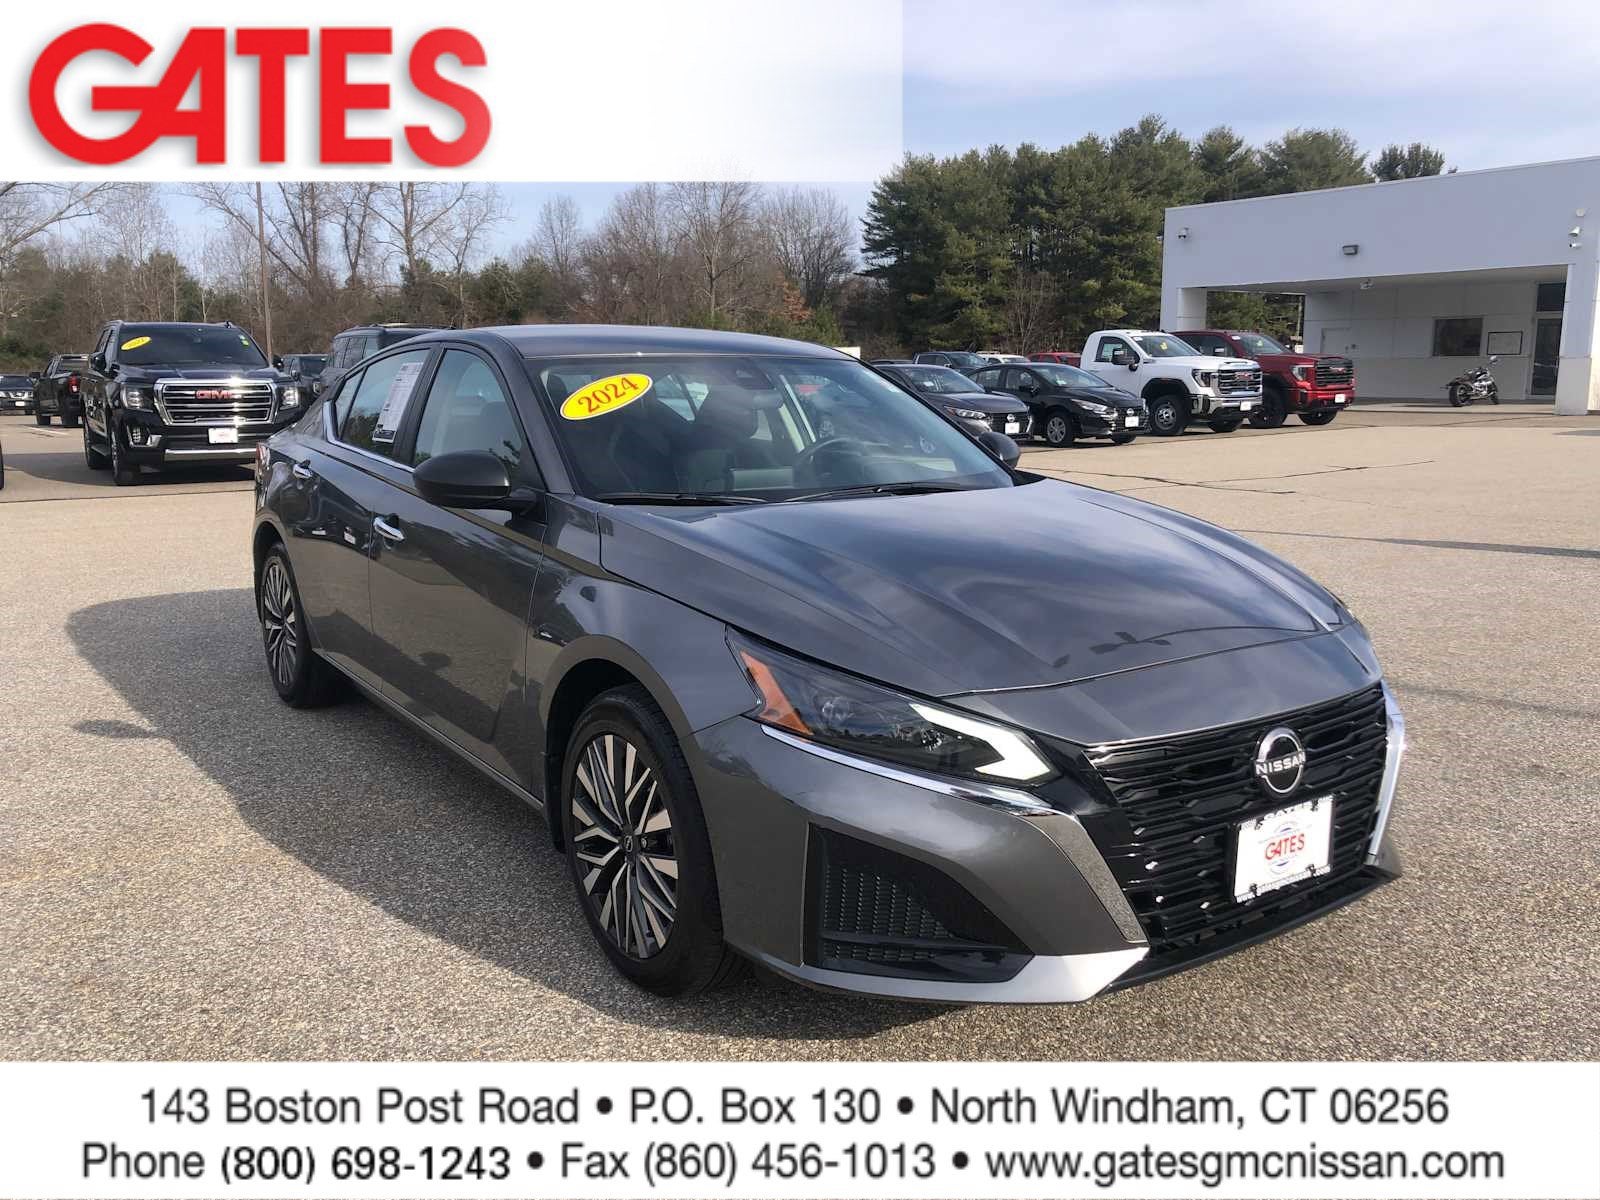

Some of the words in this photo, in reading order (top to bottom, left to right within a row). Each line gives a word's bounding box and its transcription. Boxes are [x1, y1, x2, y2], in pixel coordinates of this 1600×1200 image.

[578, 377, 638, 413] 2024
[1255, 751, 1306, 775] NISSAN
[1265, 833, 1305, 860] GATES
